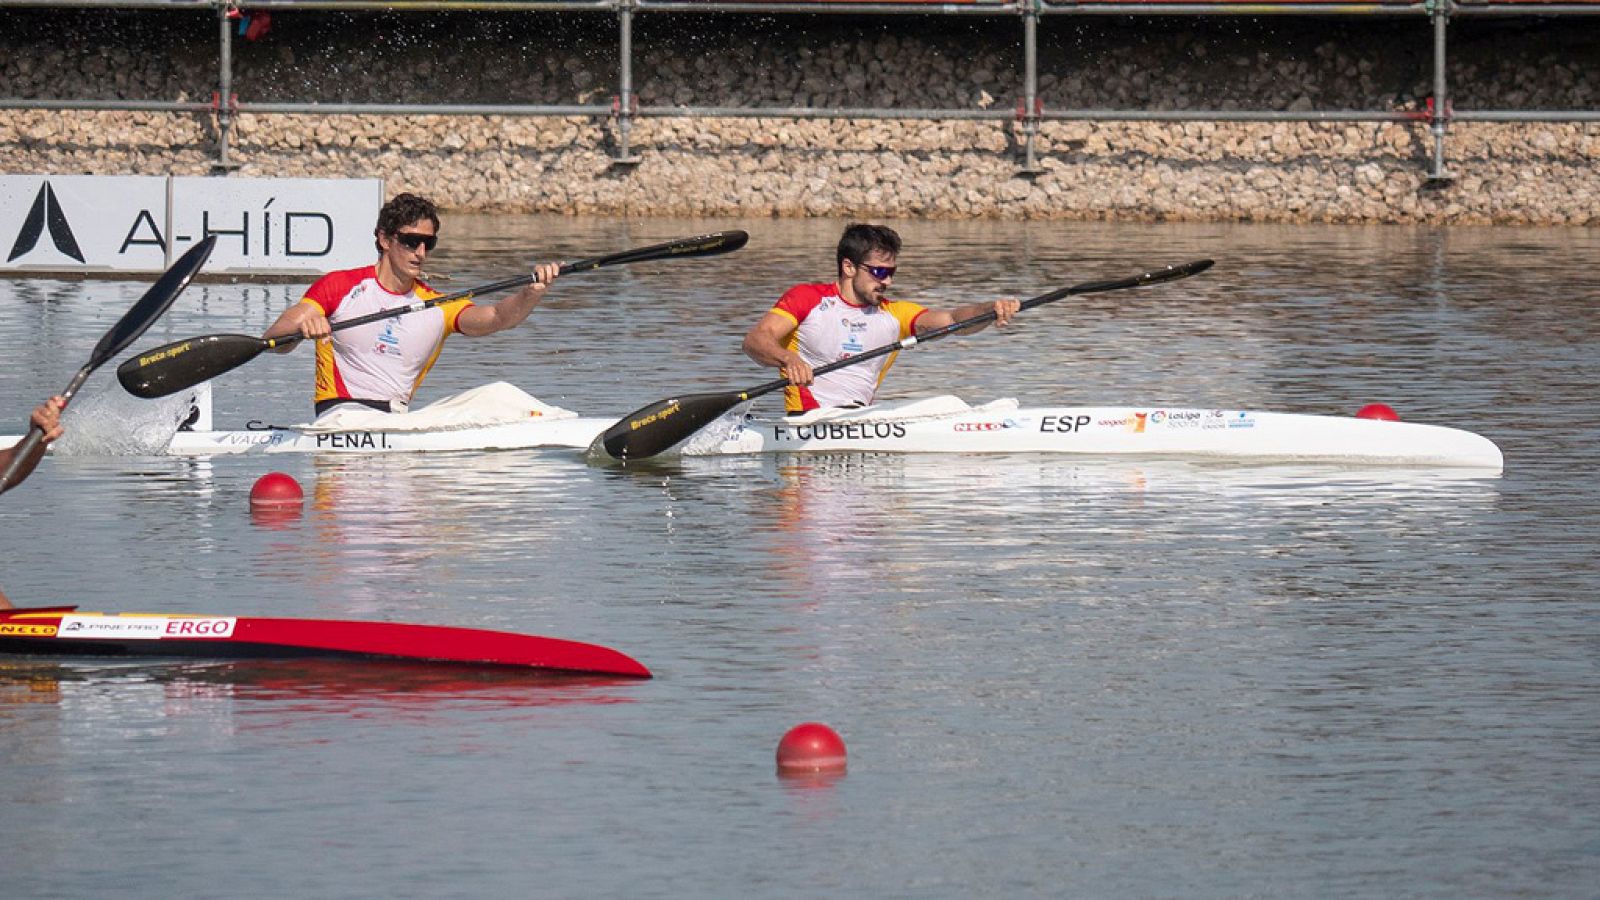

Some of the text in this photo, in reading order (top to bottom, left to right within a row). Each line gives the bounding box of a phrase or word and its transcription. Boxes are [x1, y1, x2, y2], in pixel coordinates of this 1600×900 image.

[119, 197, 333, 256] A-HÍD
[797, 422, 906, 440] CUBELOS
[1040, 416, 1090, 432] ESP
[0, 626, 55, 634] NELO
[166, 621, 229, 634] ERGO
